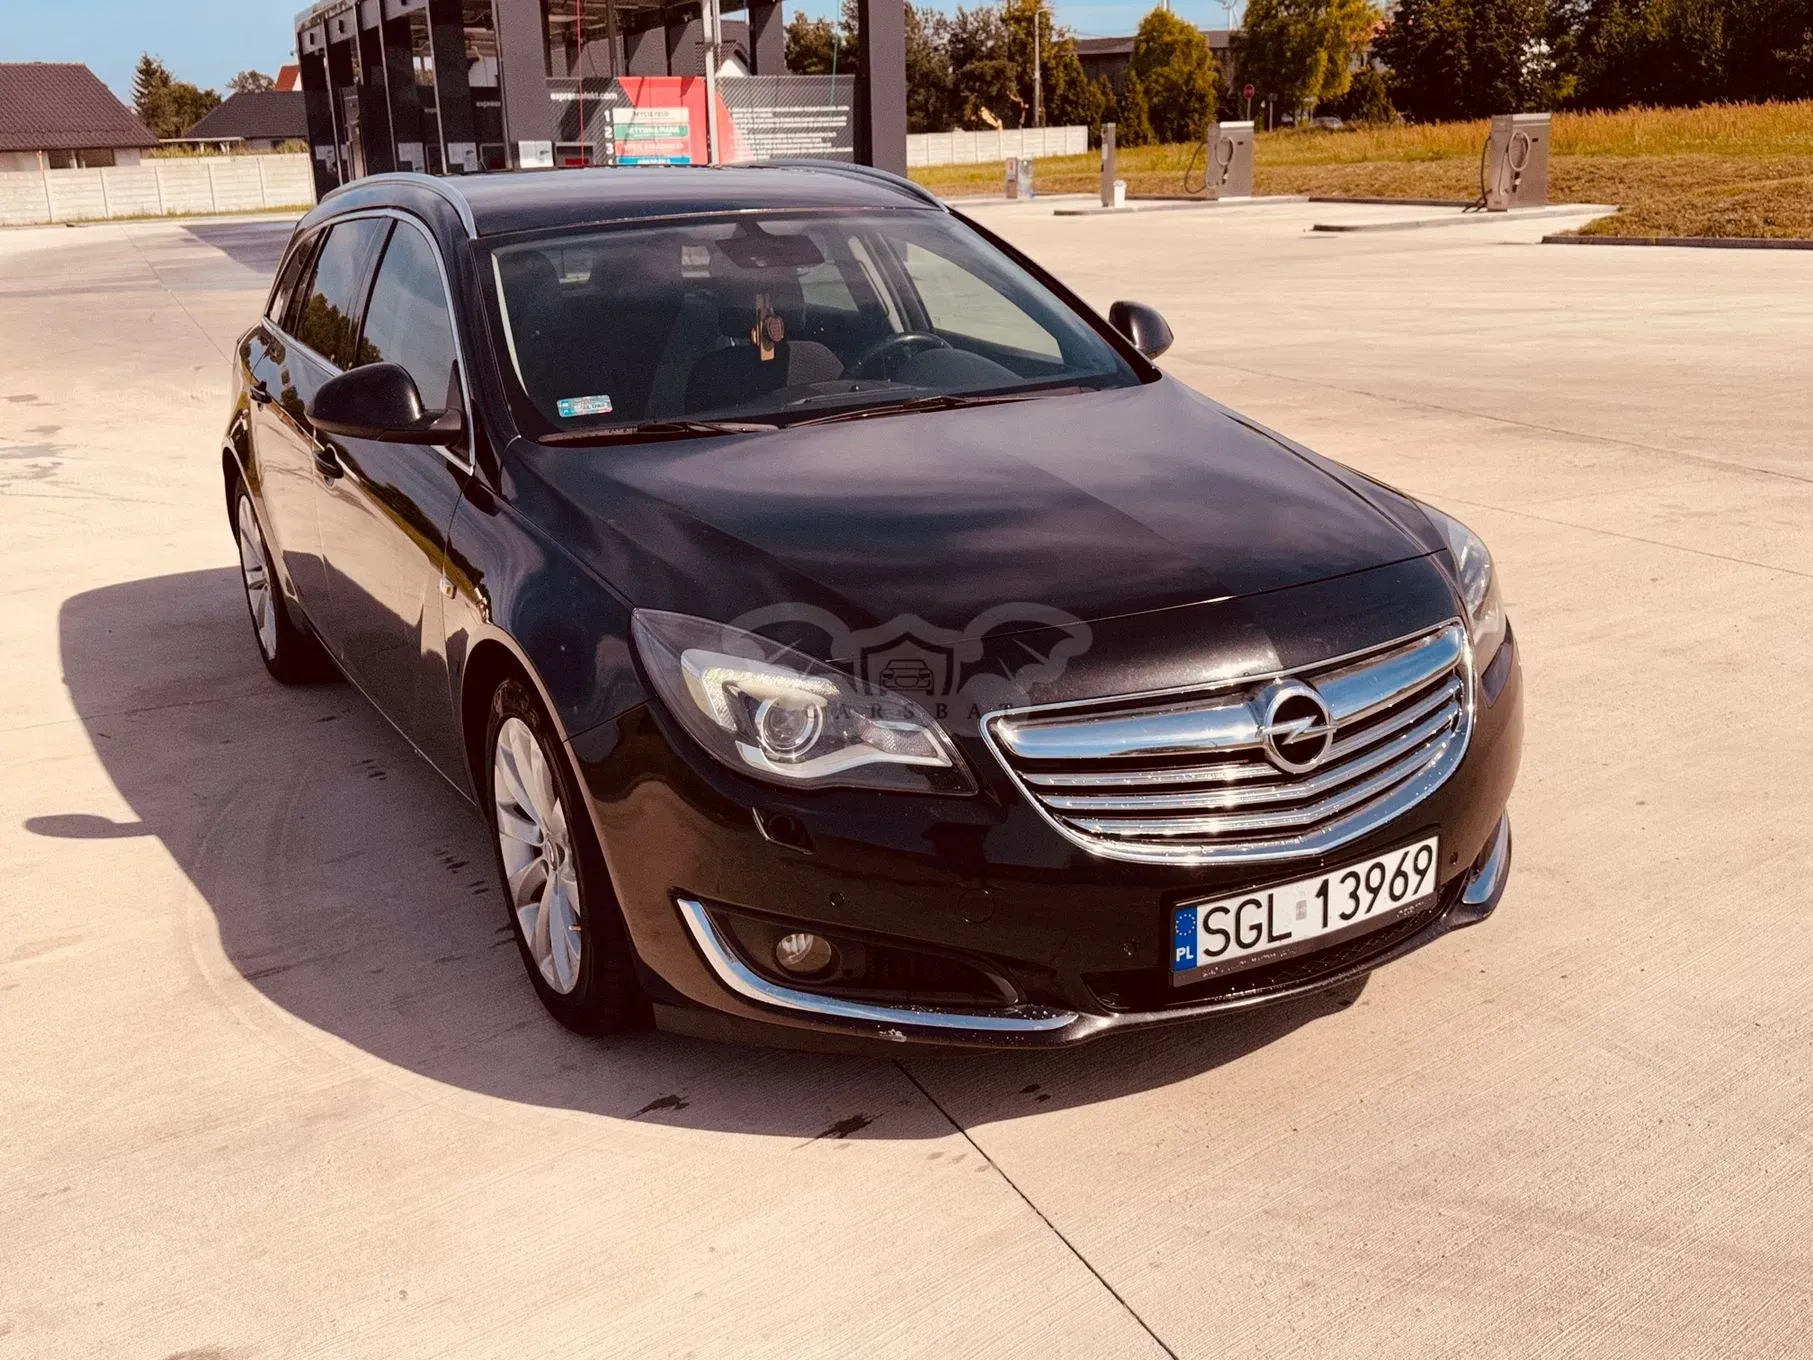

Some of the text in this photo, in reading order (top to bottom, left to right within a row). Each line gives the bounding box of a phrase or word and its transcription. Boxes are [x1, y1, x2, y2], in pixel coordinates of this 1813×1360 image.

[604, 109, 610, 122] 1
[604, 126, 613, 138] 2
[605, 142, 614, 155] 3
[1202, 844, 1434, 957] SGL 13969
[1176, 945, 1194, 962] PL
